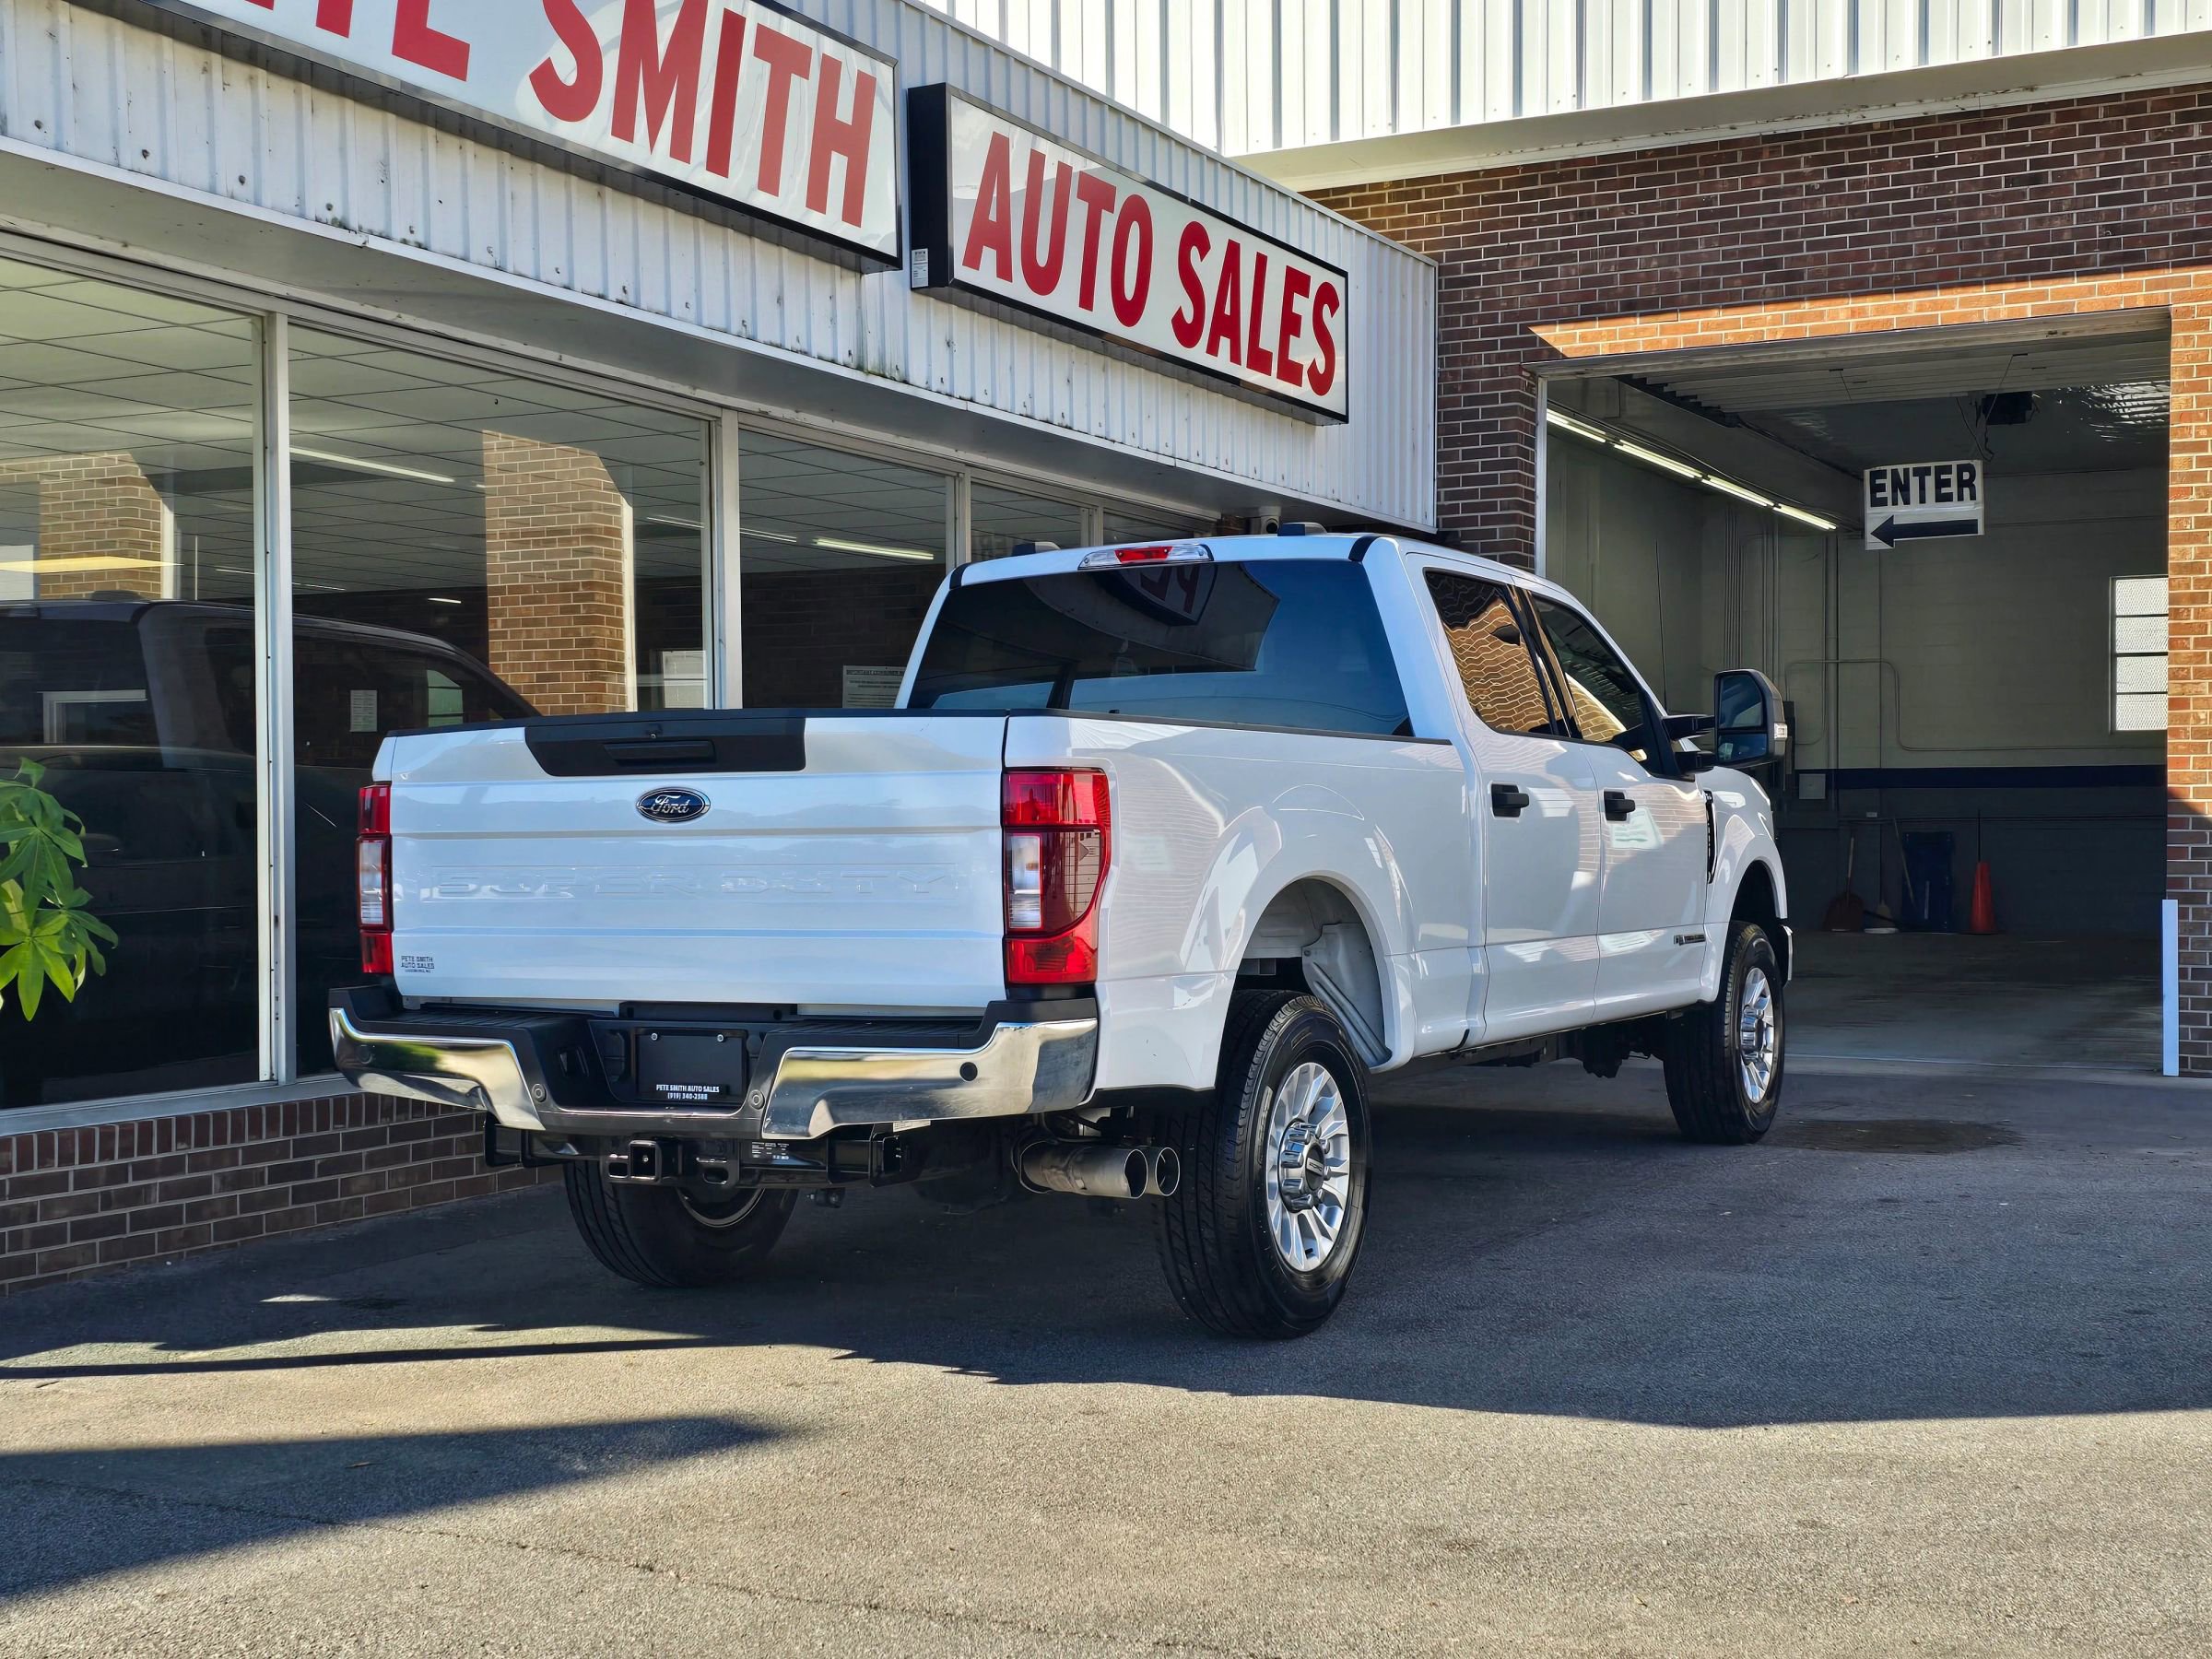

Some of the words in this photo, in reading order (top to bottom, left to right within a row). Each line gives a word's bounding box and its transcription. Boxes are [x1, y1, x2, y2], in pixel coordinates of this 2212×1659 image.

[529, 0, 877, 229] SMITH
[961, 131, 1154, 328] AUTO
[1171, 220, 1341, 397] SALES
[1869, 463, 1977, 508] ENTER
[650, 794, 690, 814] Ford
[667, 1092, 681, 1100] (919)
[669, 1084, 687, 1092] SMITH
